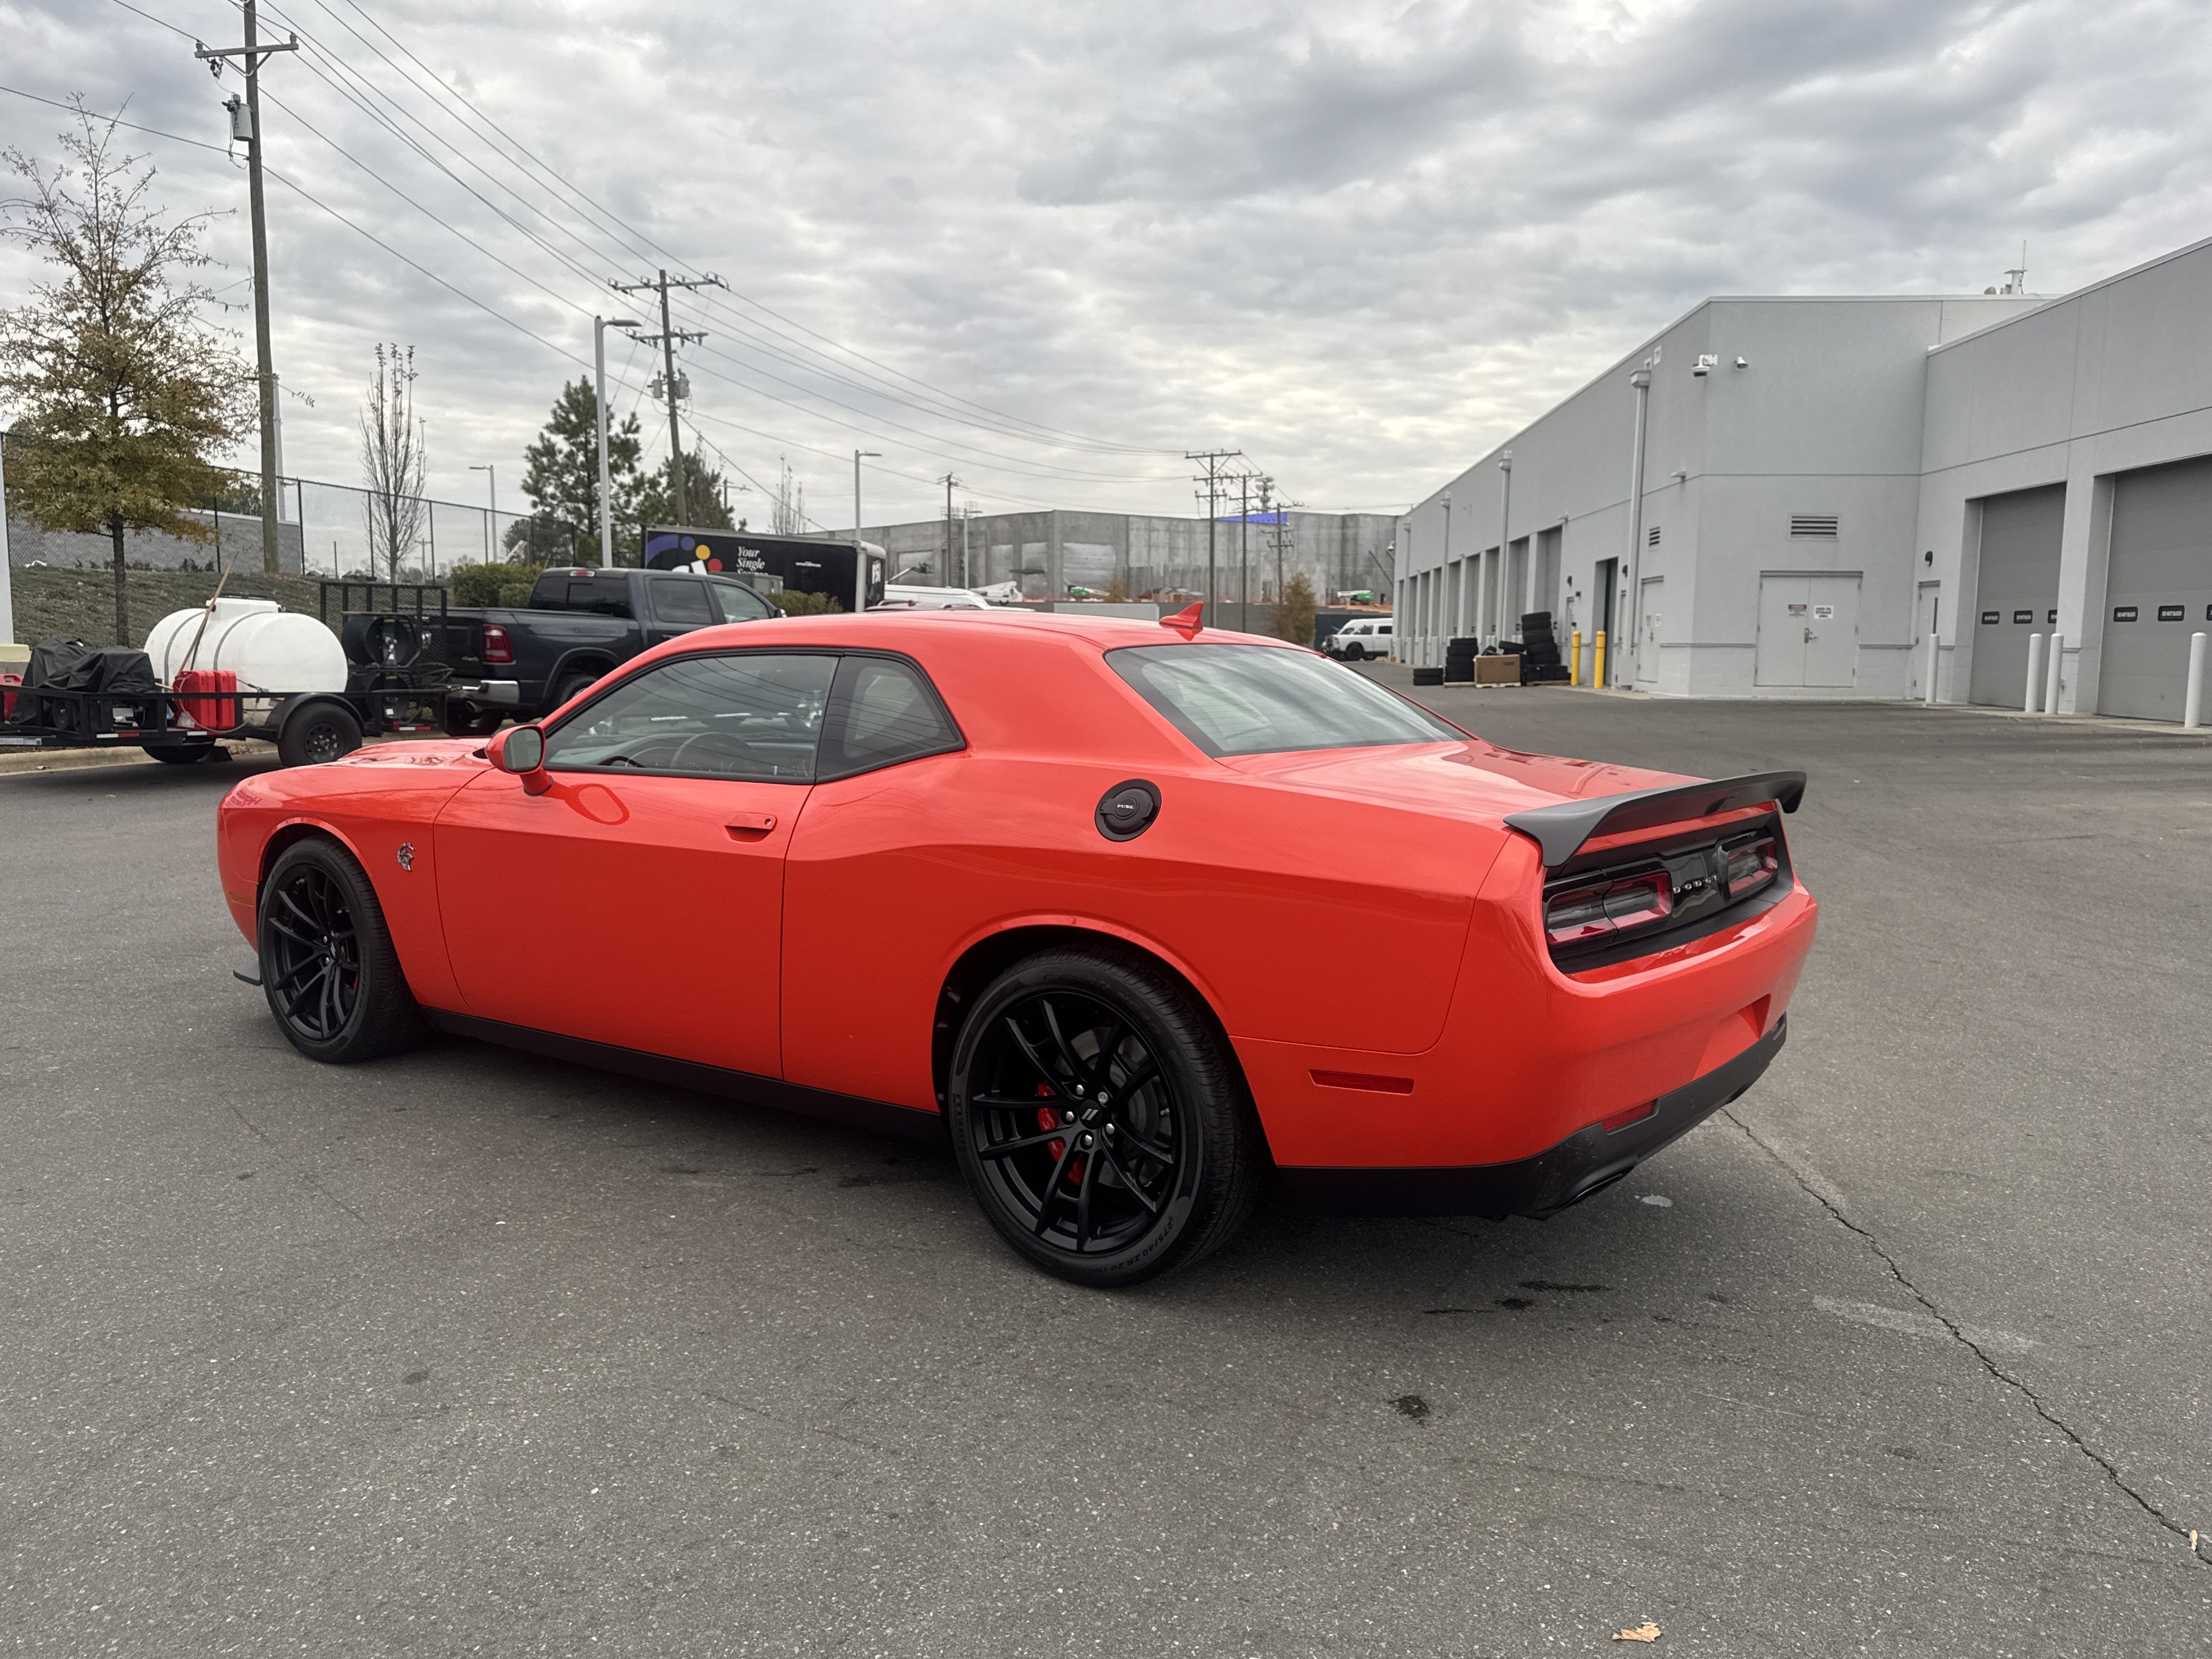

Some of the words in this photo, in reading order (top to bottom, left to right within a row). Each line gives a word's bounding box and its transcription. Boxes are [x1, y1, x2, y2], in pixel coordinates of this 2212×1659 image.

[738, 545, 760, 558] Your
[736, 557, 765, 571] Single
[1673, 874, 1720, 894] DODGE
[1110, 1262, 1124, 1272] 20
